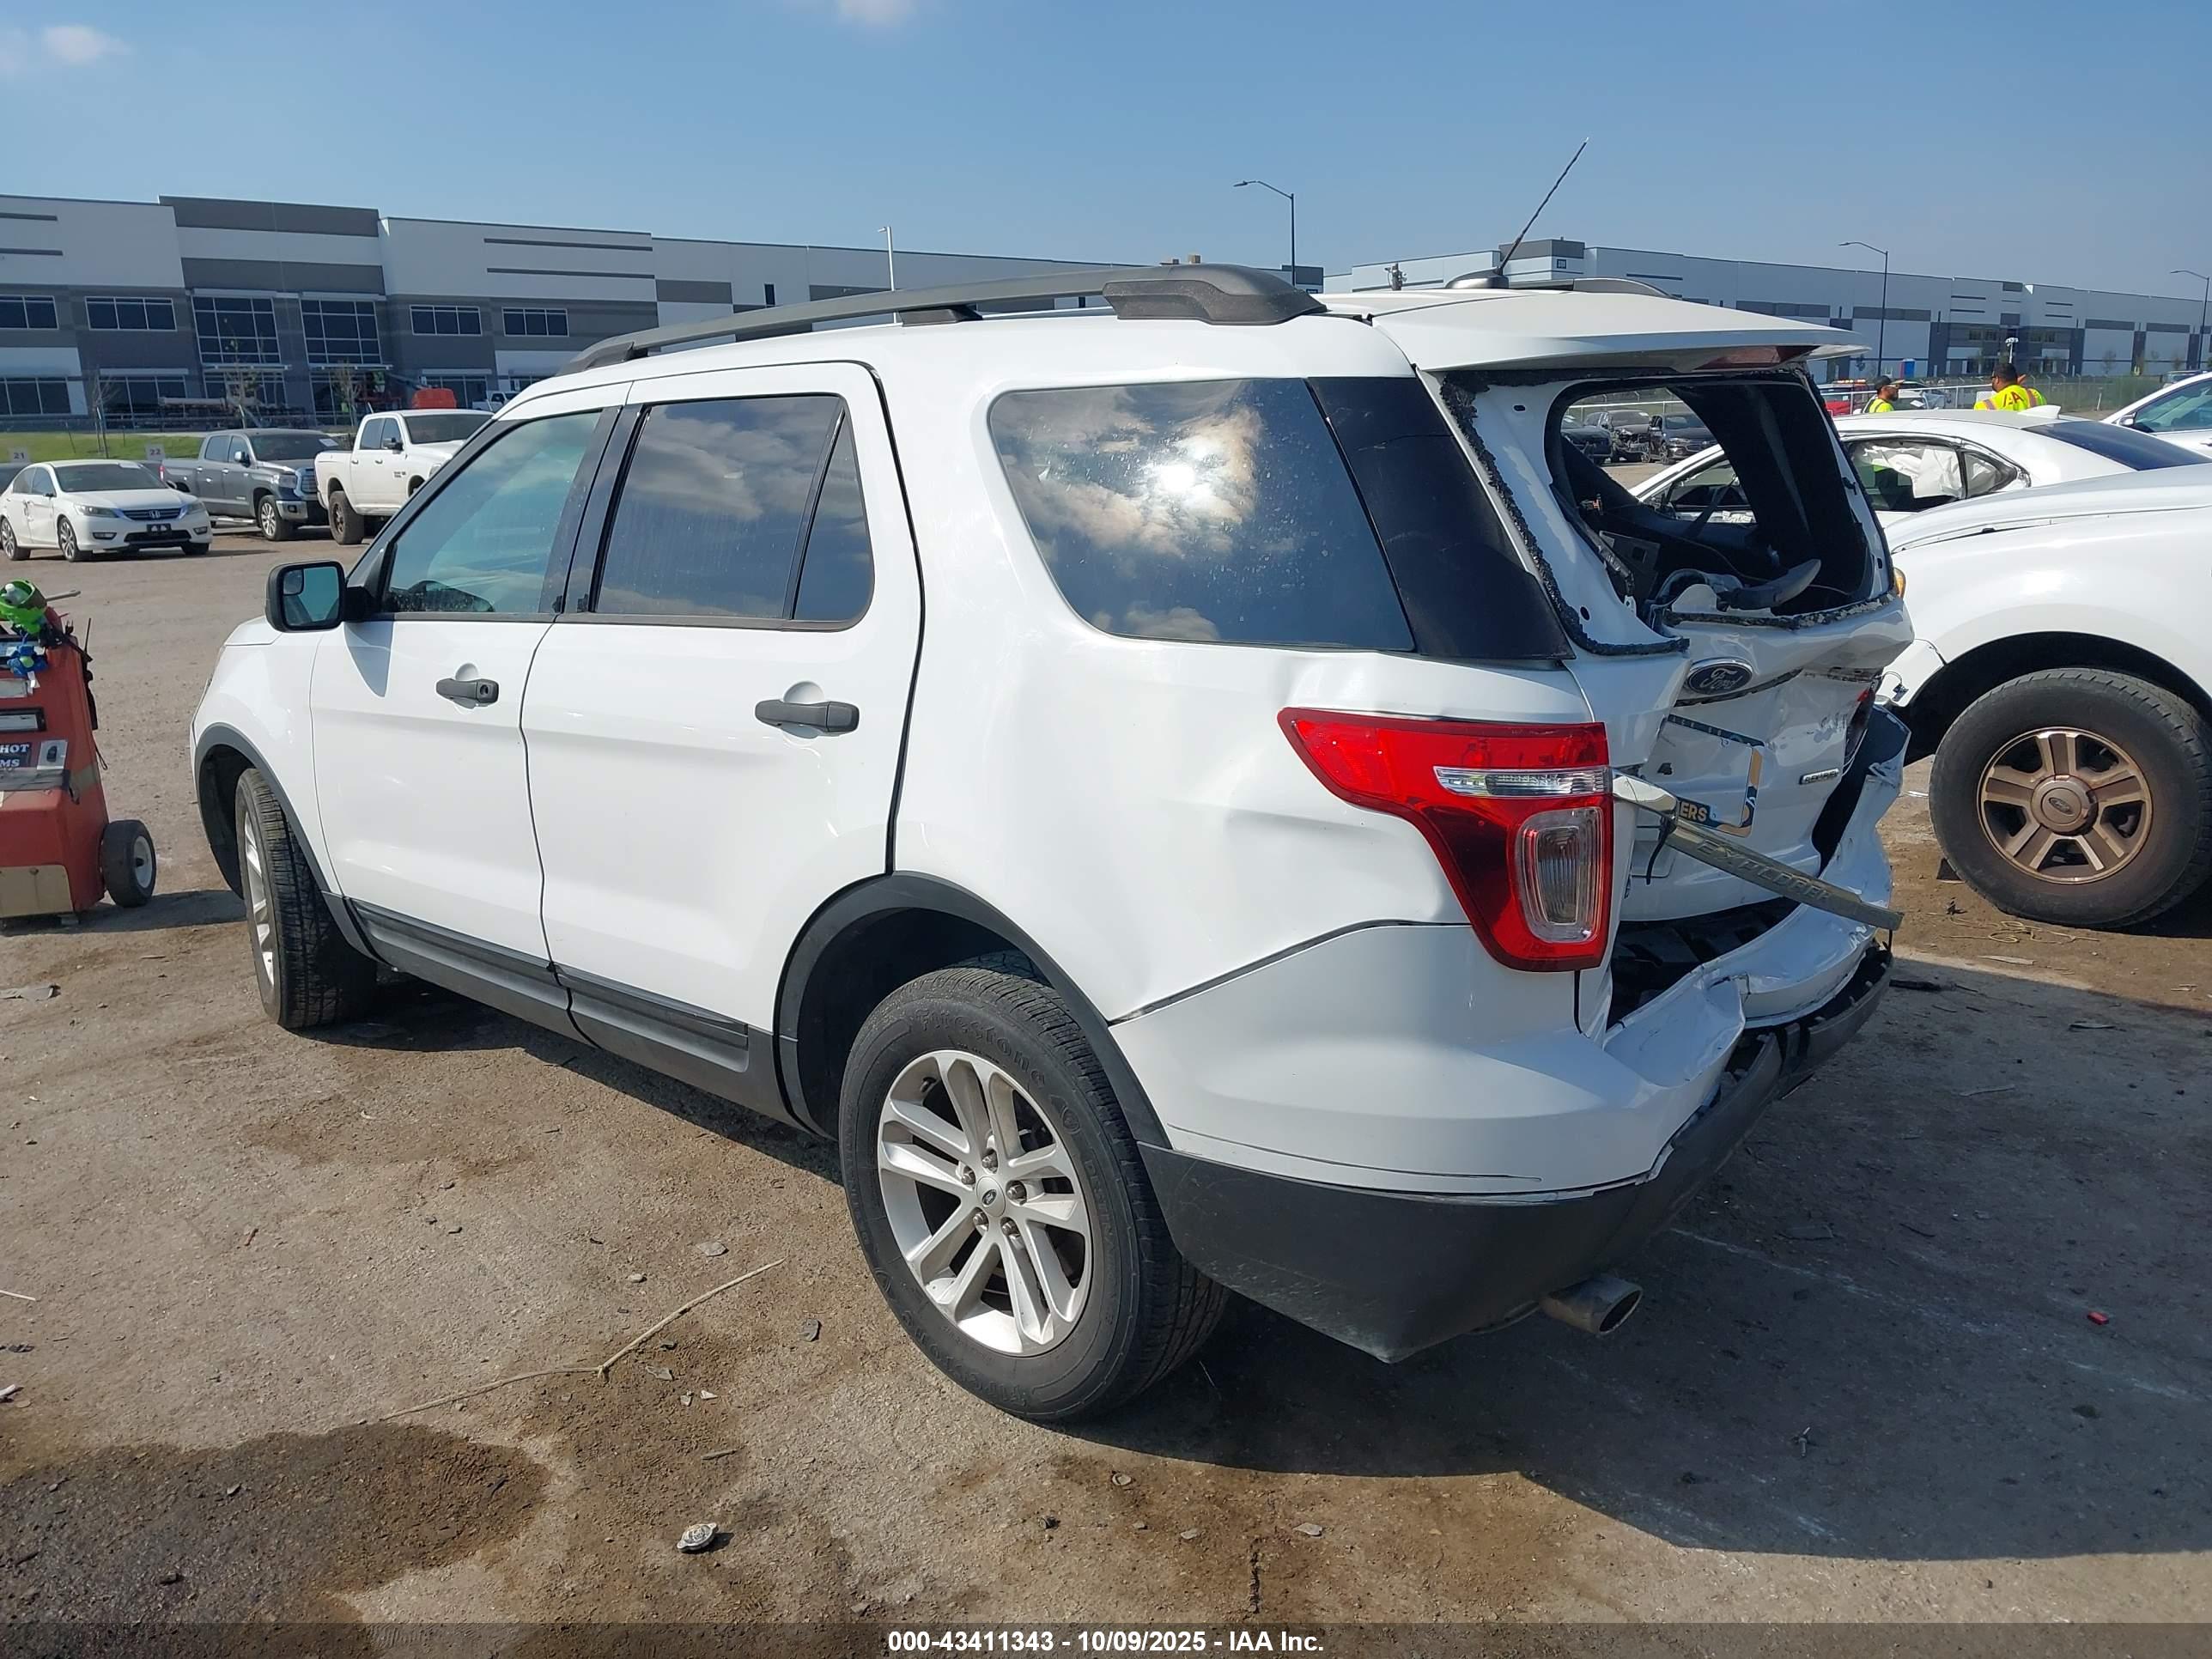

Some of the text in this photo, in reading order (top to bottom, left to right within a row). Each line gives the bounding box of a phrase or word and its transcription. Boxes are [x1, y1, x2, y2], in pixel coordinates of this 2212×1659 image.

[1699, 668, 1743, 689] Ford
[1697, 839, 1830, 900] EXPLORER
[917, 1009, 1045, 1086] Firestone
